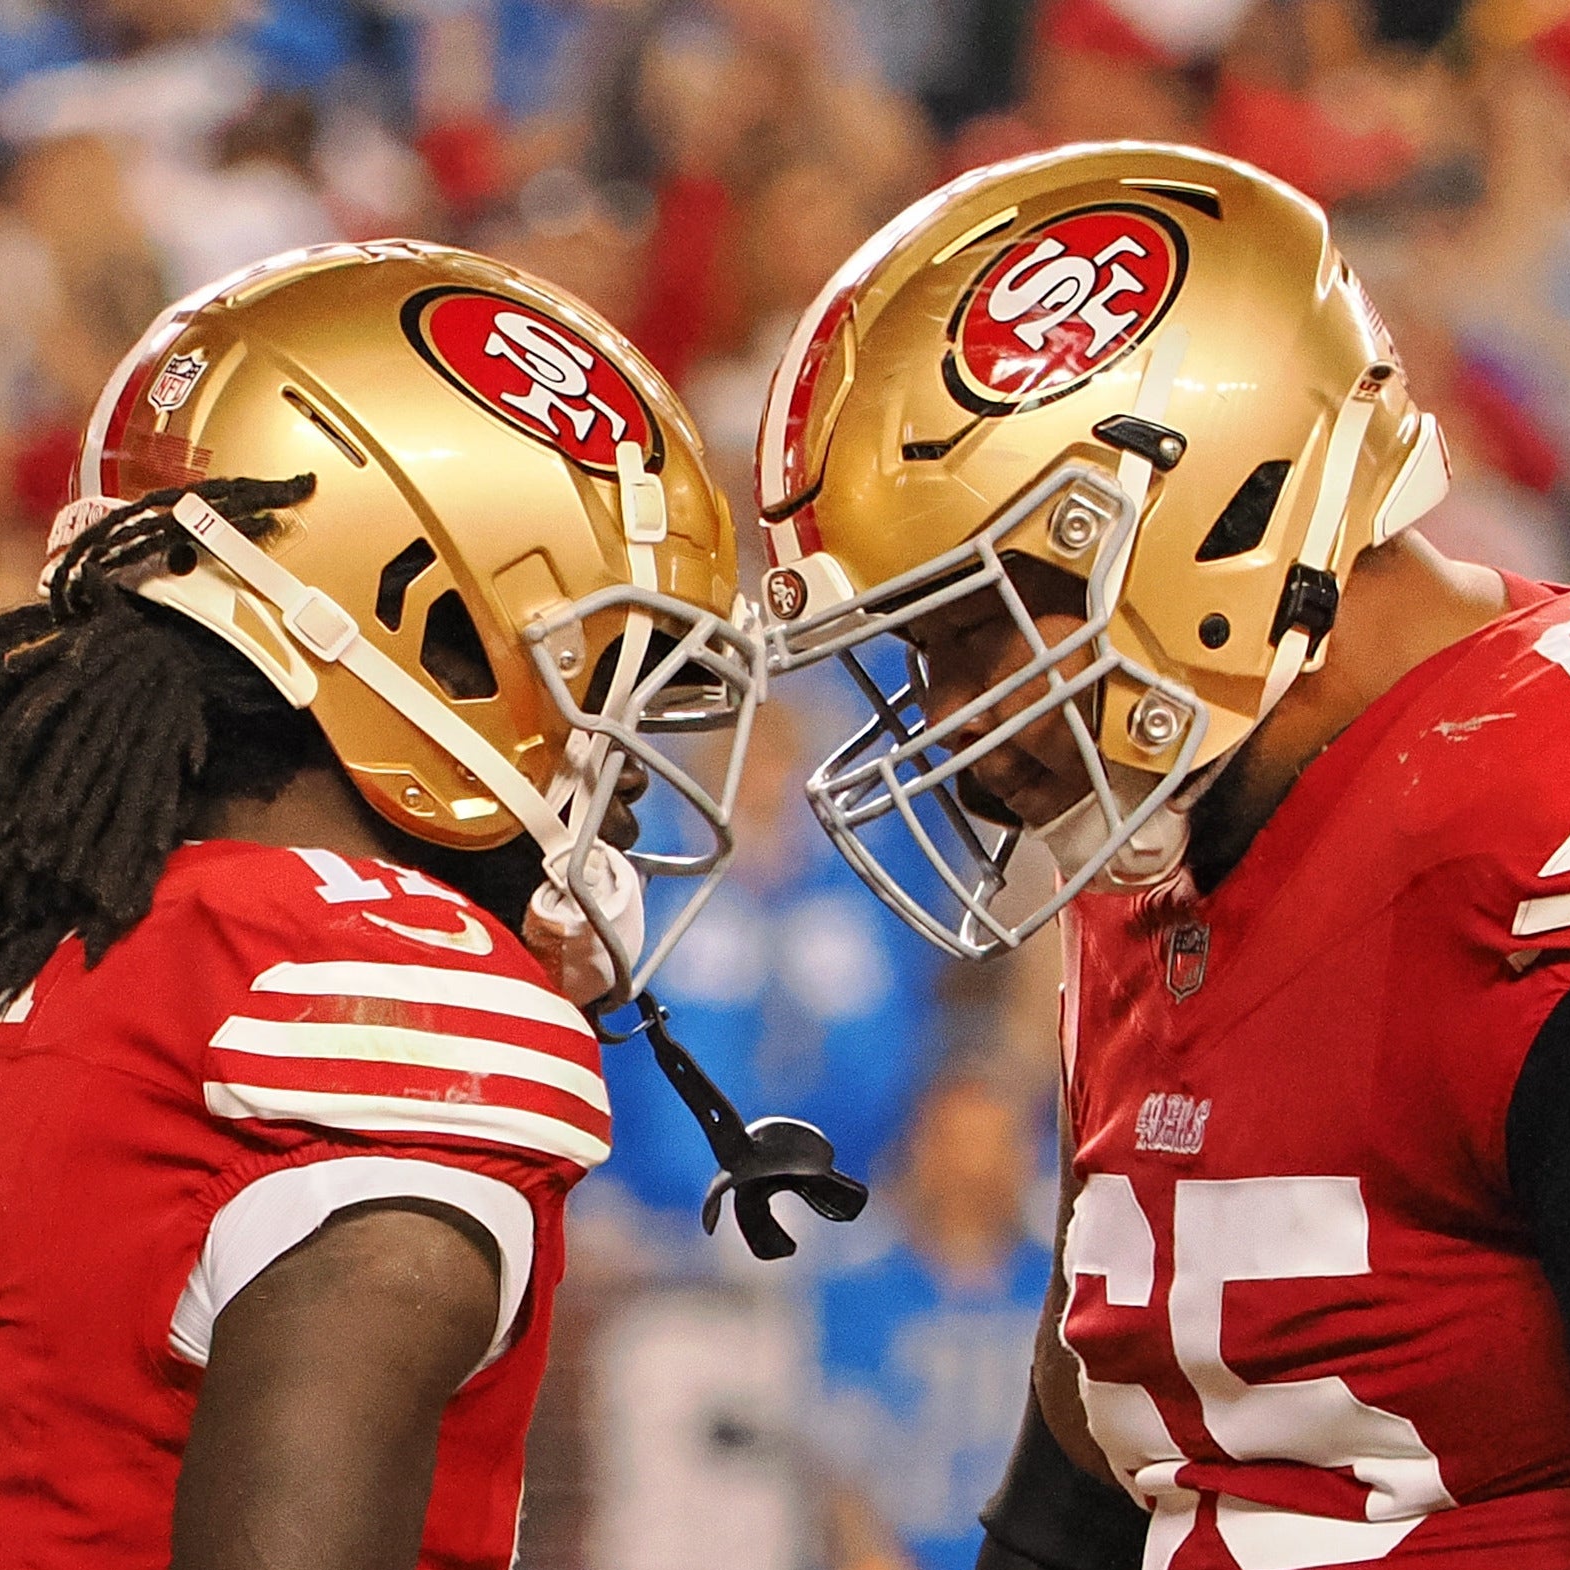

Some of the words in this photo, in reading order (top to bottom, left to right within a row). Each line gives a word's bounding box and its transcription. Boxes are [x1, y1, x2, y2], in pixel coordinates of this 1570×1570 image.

[987, 235, 1148, 359] SF
[154, 374, 187, 402] NFL
[484, 311, 627, 442] SF
[193, 512, 216, 536] 11
